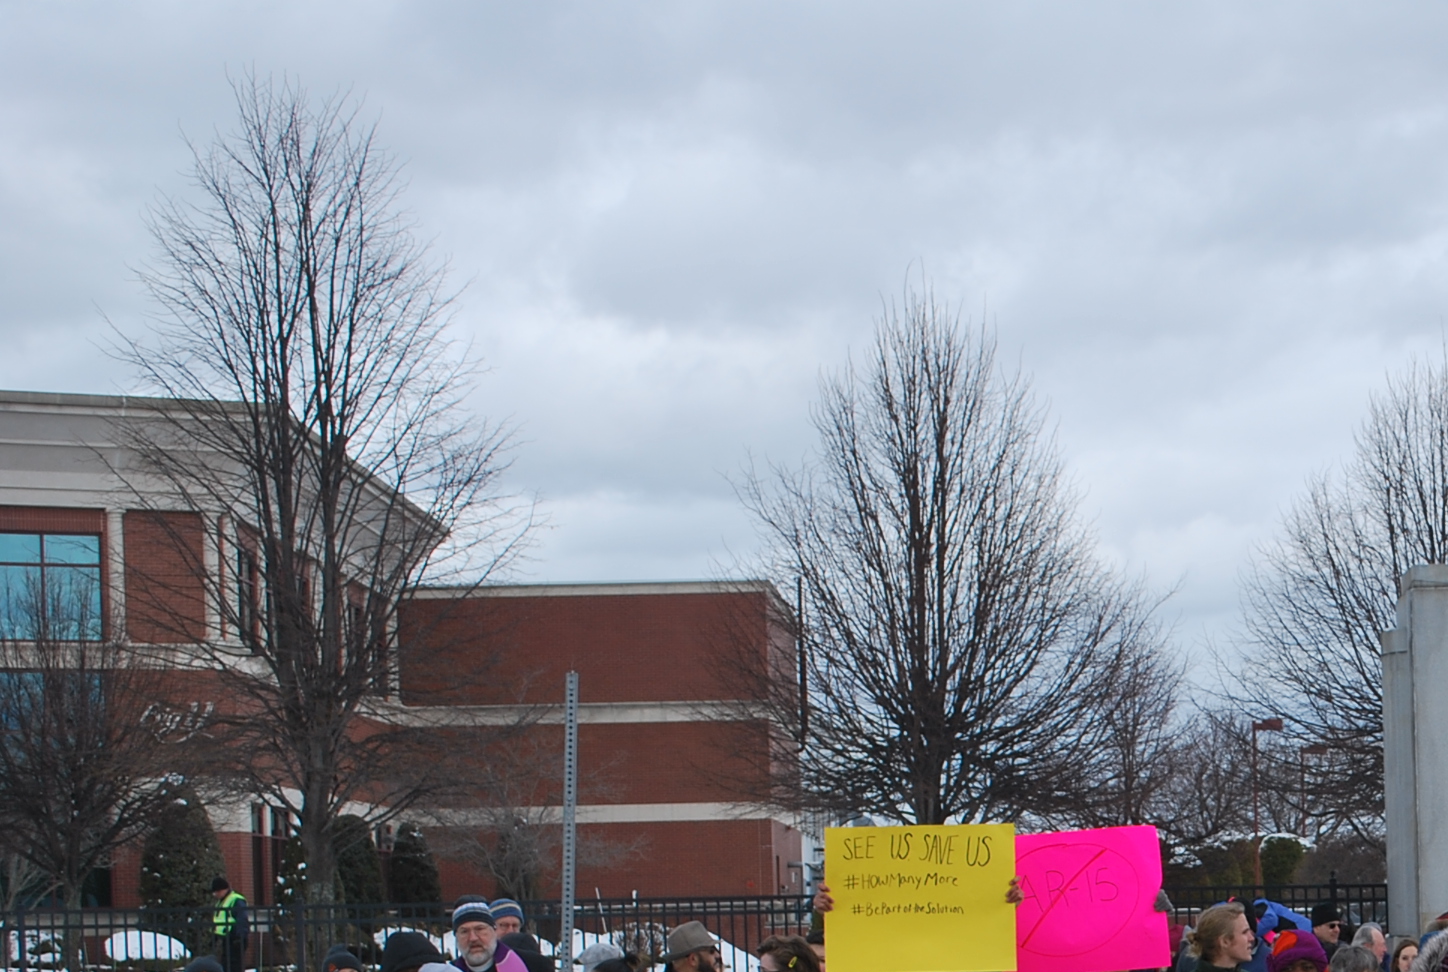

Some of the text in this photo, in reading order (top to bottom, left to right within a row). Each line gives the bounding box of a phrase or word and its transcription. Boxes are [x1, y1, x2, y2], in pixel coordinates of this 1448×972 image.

[842, 835, 876, 861] SEE
[918, 834, 959, 866] SAVE
[966, 835, 993, 867] US
[1021, 867, 1119, 913] AR-15
